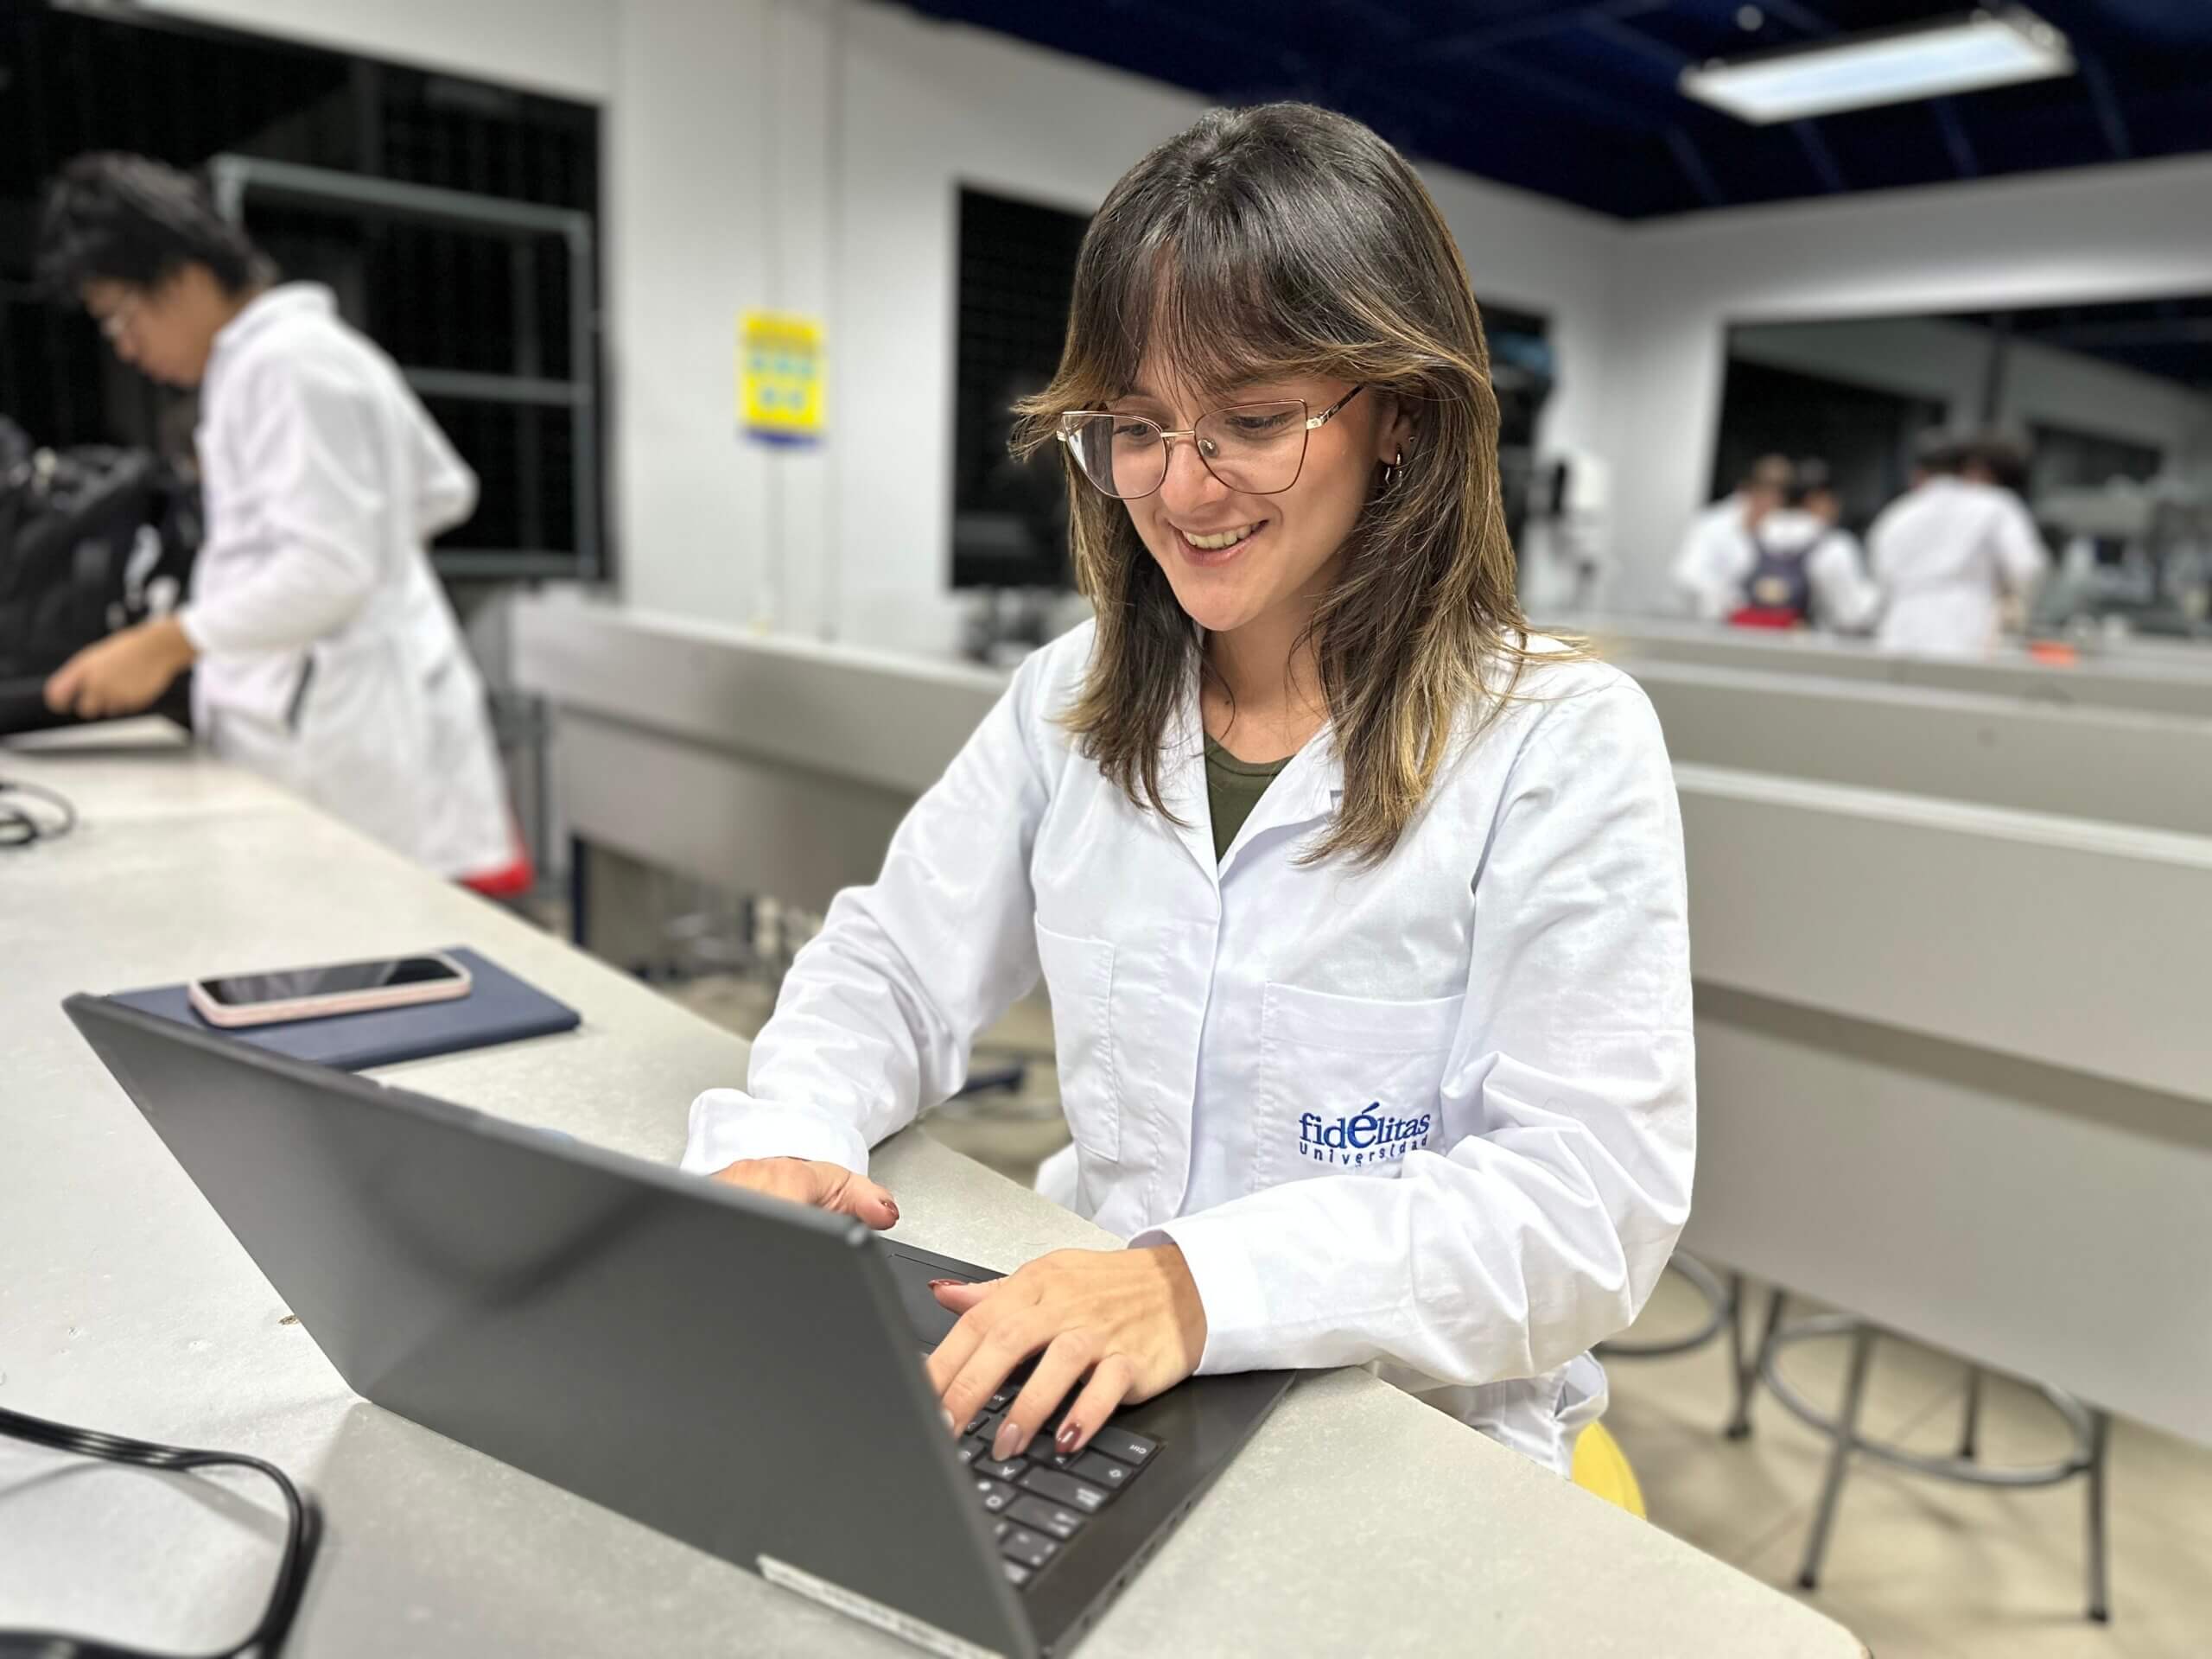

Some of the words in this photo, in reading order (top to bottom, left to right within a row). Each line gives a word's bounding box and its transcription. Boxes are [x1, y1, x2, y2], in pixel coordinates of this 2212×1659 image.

[1299, 1102, 1431, 1148] fidélitas
[1300, 1135, 1428, 1165] universidad
[1128, 1443, 1147, 1455] Ctrl
[1001, 1465, 1015, 1476] A
